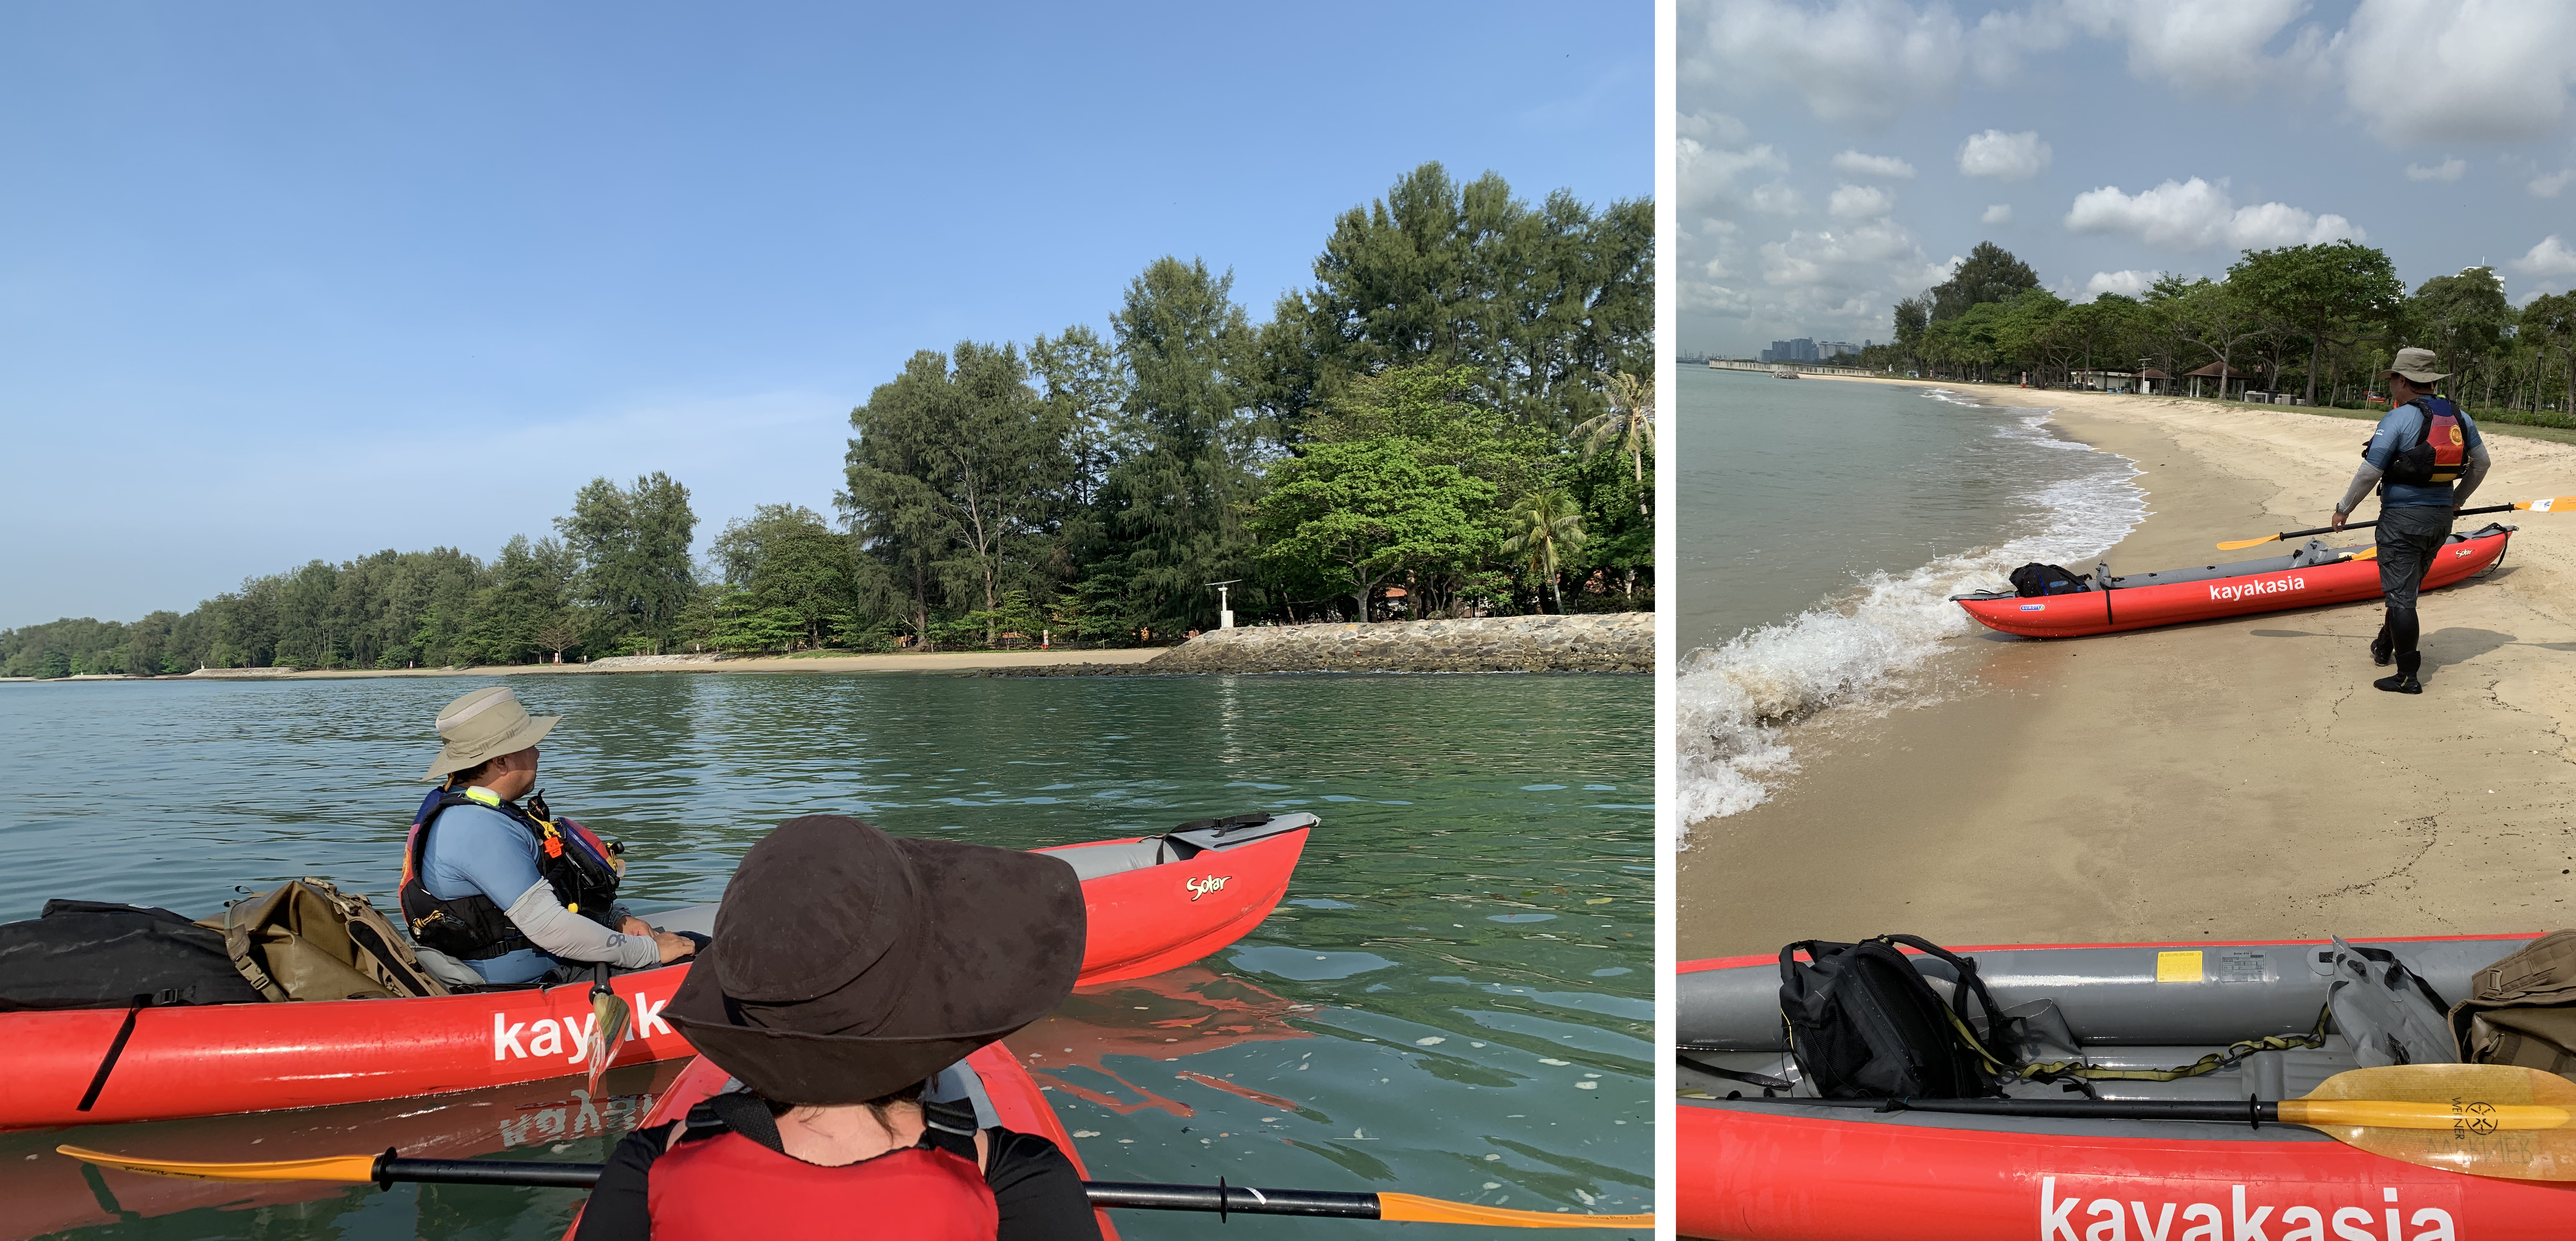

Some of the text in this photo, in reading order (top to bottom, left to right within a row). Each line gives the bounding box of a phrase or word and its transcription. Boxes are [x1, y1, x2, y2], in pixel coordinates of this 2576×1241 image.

[2455, 548, 2475, 559] Solar
[2209, 576, 2305, 601] kayakasia
[1186, 873, 1232, 902] Solar
[494, 992, 671, 1064] kayk
[2041, 1176, 2455, 1241] kayakasia
